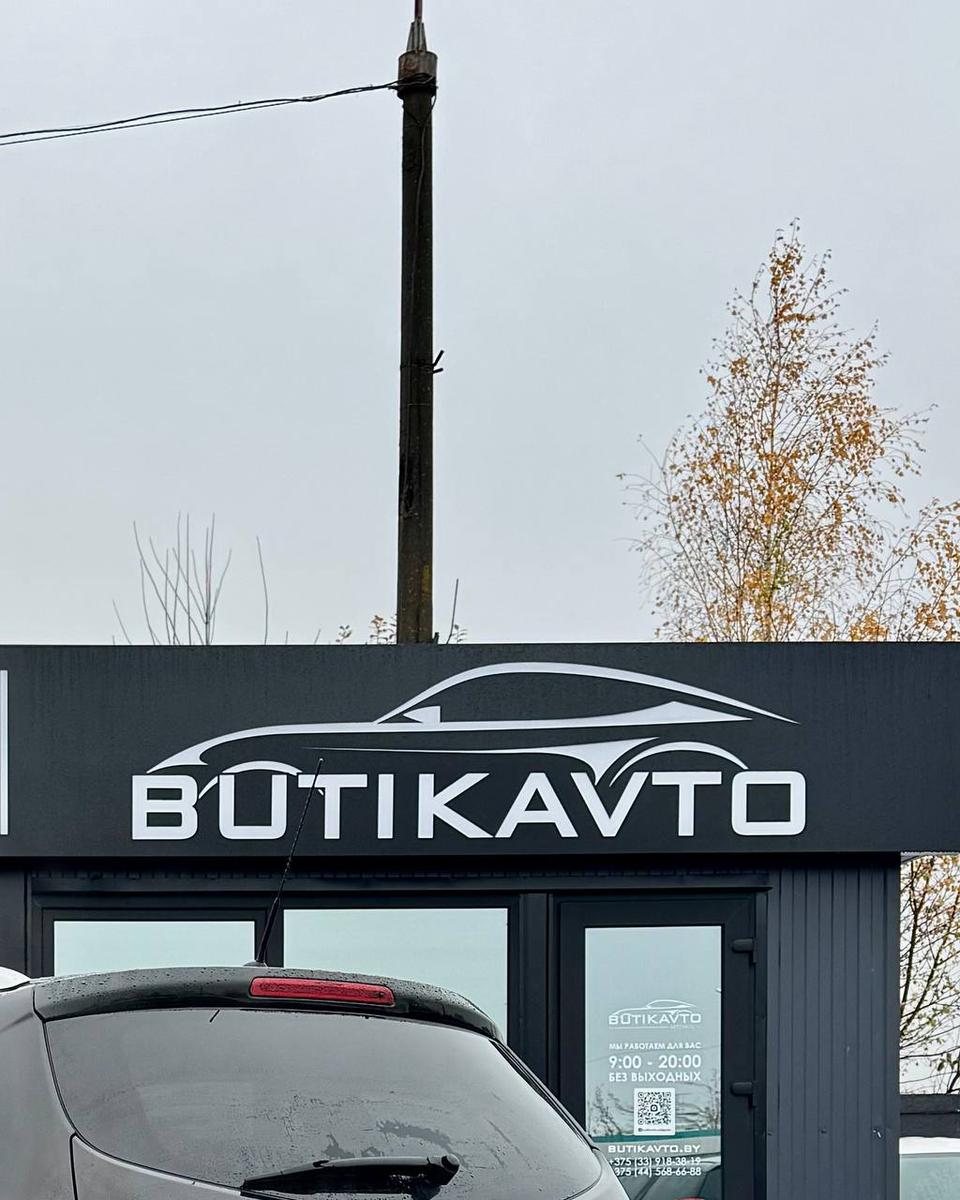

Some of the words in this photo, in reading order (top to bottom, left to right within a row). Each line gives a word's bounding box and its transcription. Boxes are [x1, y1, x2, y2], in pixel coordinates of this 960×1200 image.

[131, 770, 807, 841] BUTIKAVTO
[608, 1013, 701, 1025] BUTIKAVTO
[624, 1042, 665, 1050] РАБОТАЕМ
[609, 1055, 642, 1069] 9:00
[658, 1054, 701, 1068] 20:00
[609, 1072, 628, 1082] БЕЗ
[631, 1071, 701, 1083] ВЫХОДНЫХ
[608, 1144, 701, 1153] BUTIKAVTO.BY
[634, 1157, 652, 1168] (33)
[655, 1157, 701, 1166] 918-38-19
[614, 1167, 632, 1176] 375
[634, 1167, 652, 1178] (44)
[655, 1166, 702, 1176] 568-66-88
